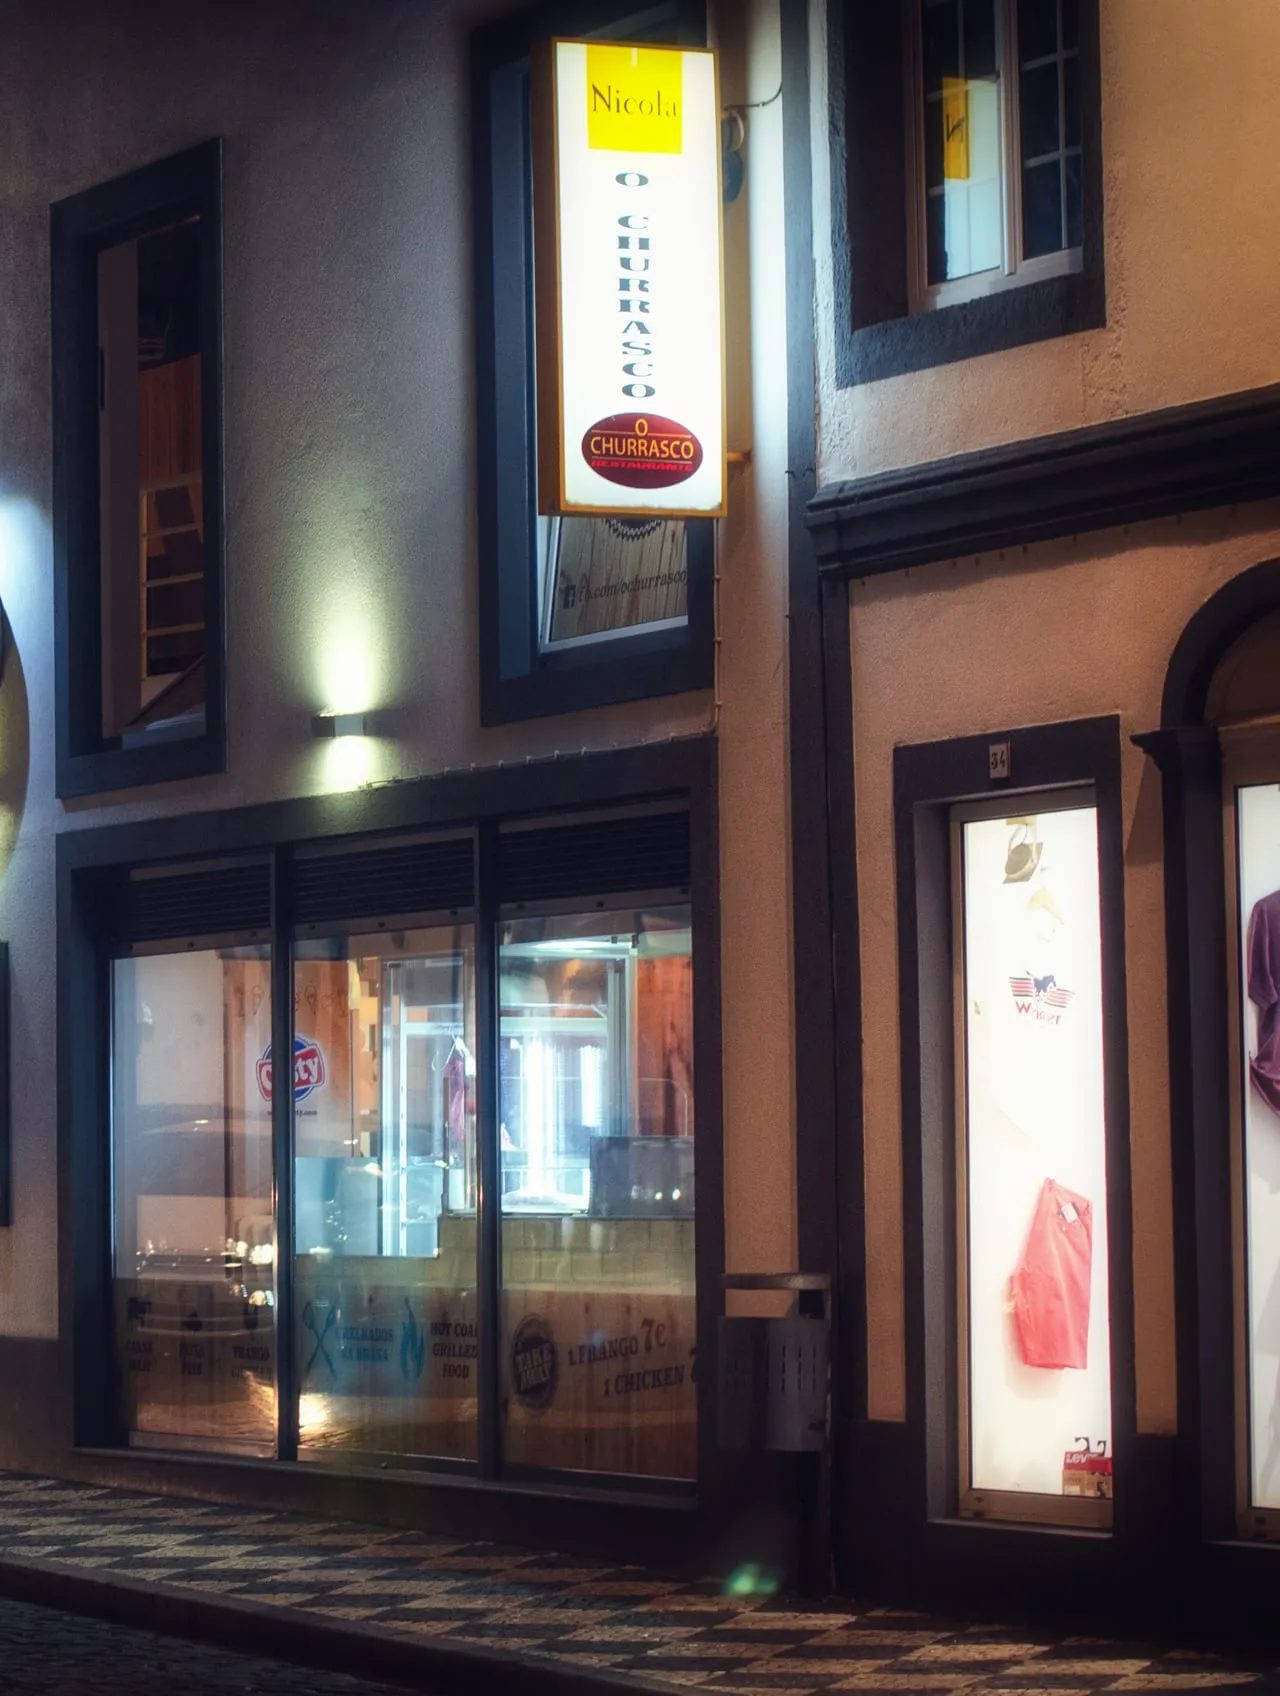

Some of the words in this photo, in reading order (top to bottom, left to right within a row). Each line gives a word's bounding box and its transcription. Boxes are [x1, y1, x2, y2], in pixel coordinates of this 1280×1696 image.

[591, 82, 679, 120] Nicola
[614, 170, 649, 188] O
[614, 213, 657, 401] CHURRASCO
[634, 417, 649, 437] O
[589, 436, 695, 460] CHURRASCO
[991, 751, 1006, 770] 34
[577, 1335, 639, 1365] FRANGO
[442, 1364, 470, 1380] FOOD
[614, 1363, 686, 1396] CHICKEN
